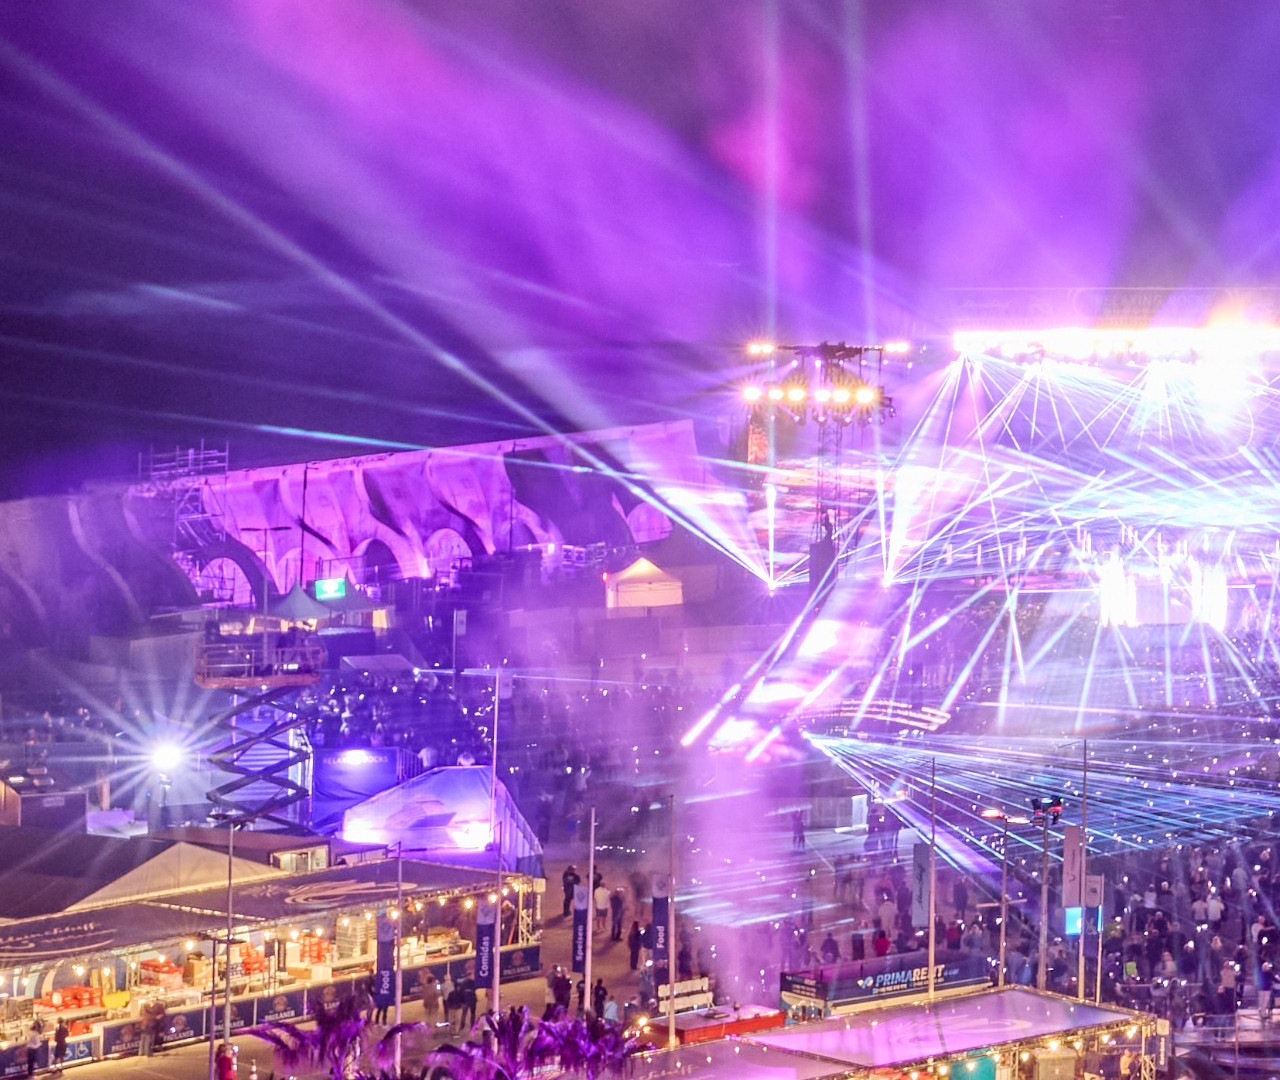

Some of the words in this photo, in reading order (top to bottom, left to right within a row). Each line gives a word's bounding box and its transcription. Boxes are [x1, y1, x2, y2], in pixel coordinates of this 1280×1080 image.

[576, 924, 584, 962] Speisen
[656, 925, 665, 949] Food
[480, 936, 490, 977] Comidas
[380, 970, 390, 994] Food
[875, 964, 946, 987] PRIMARET
[214, 1019, 245, 1033] PAUANER
[265, 1010, 296, 1021] PAULANER
[111, 1040, 142, 1053] PAULANE
[163, 1029, 195, 1042] PAULANER
